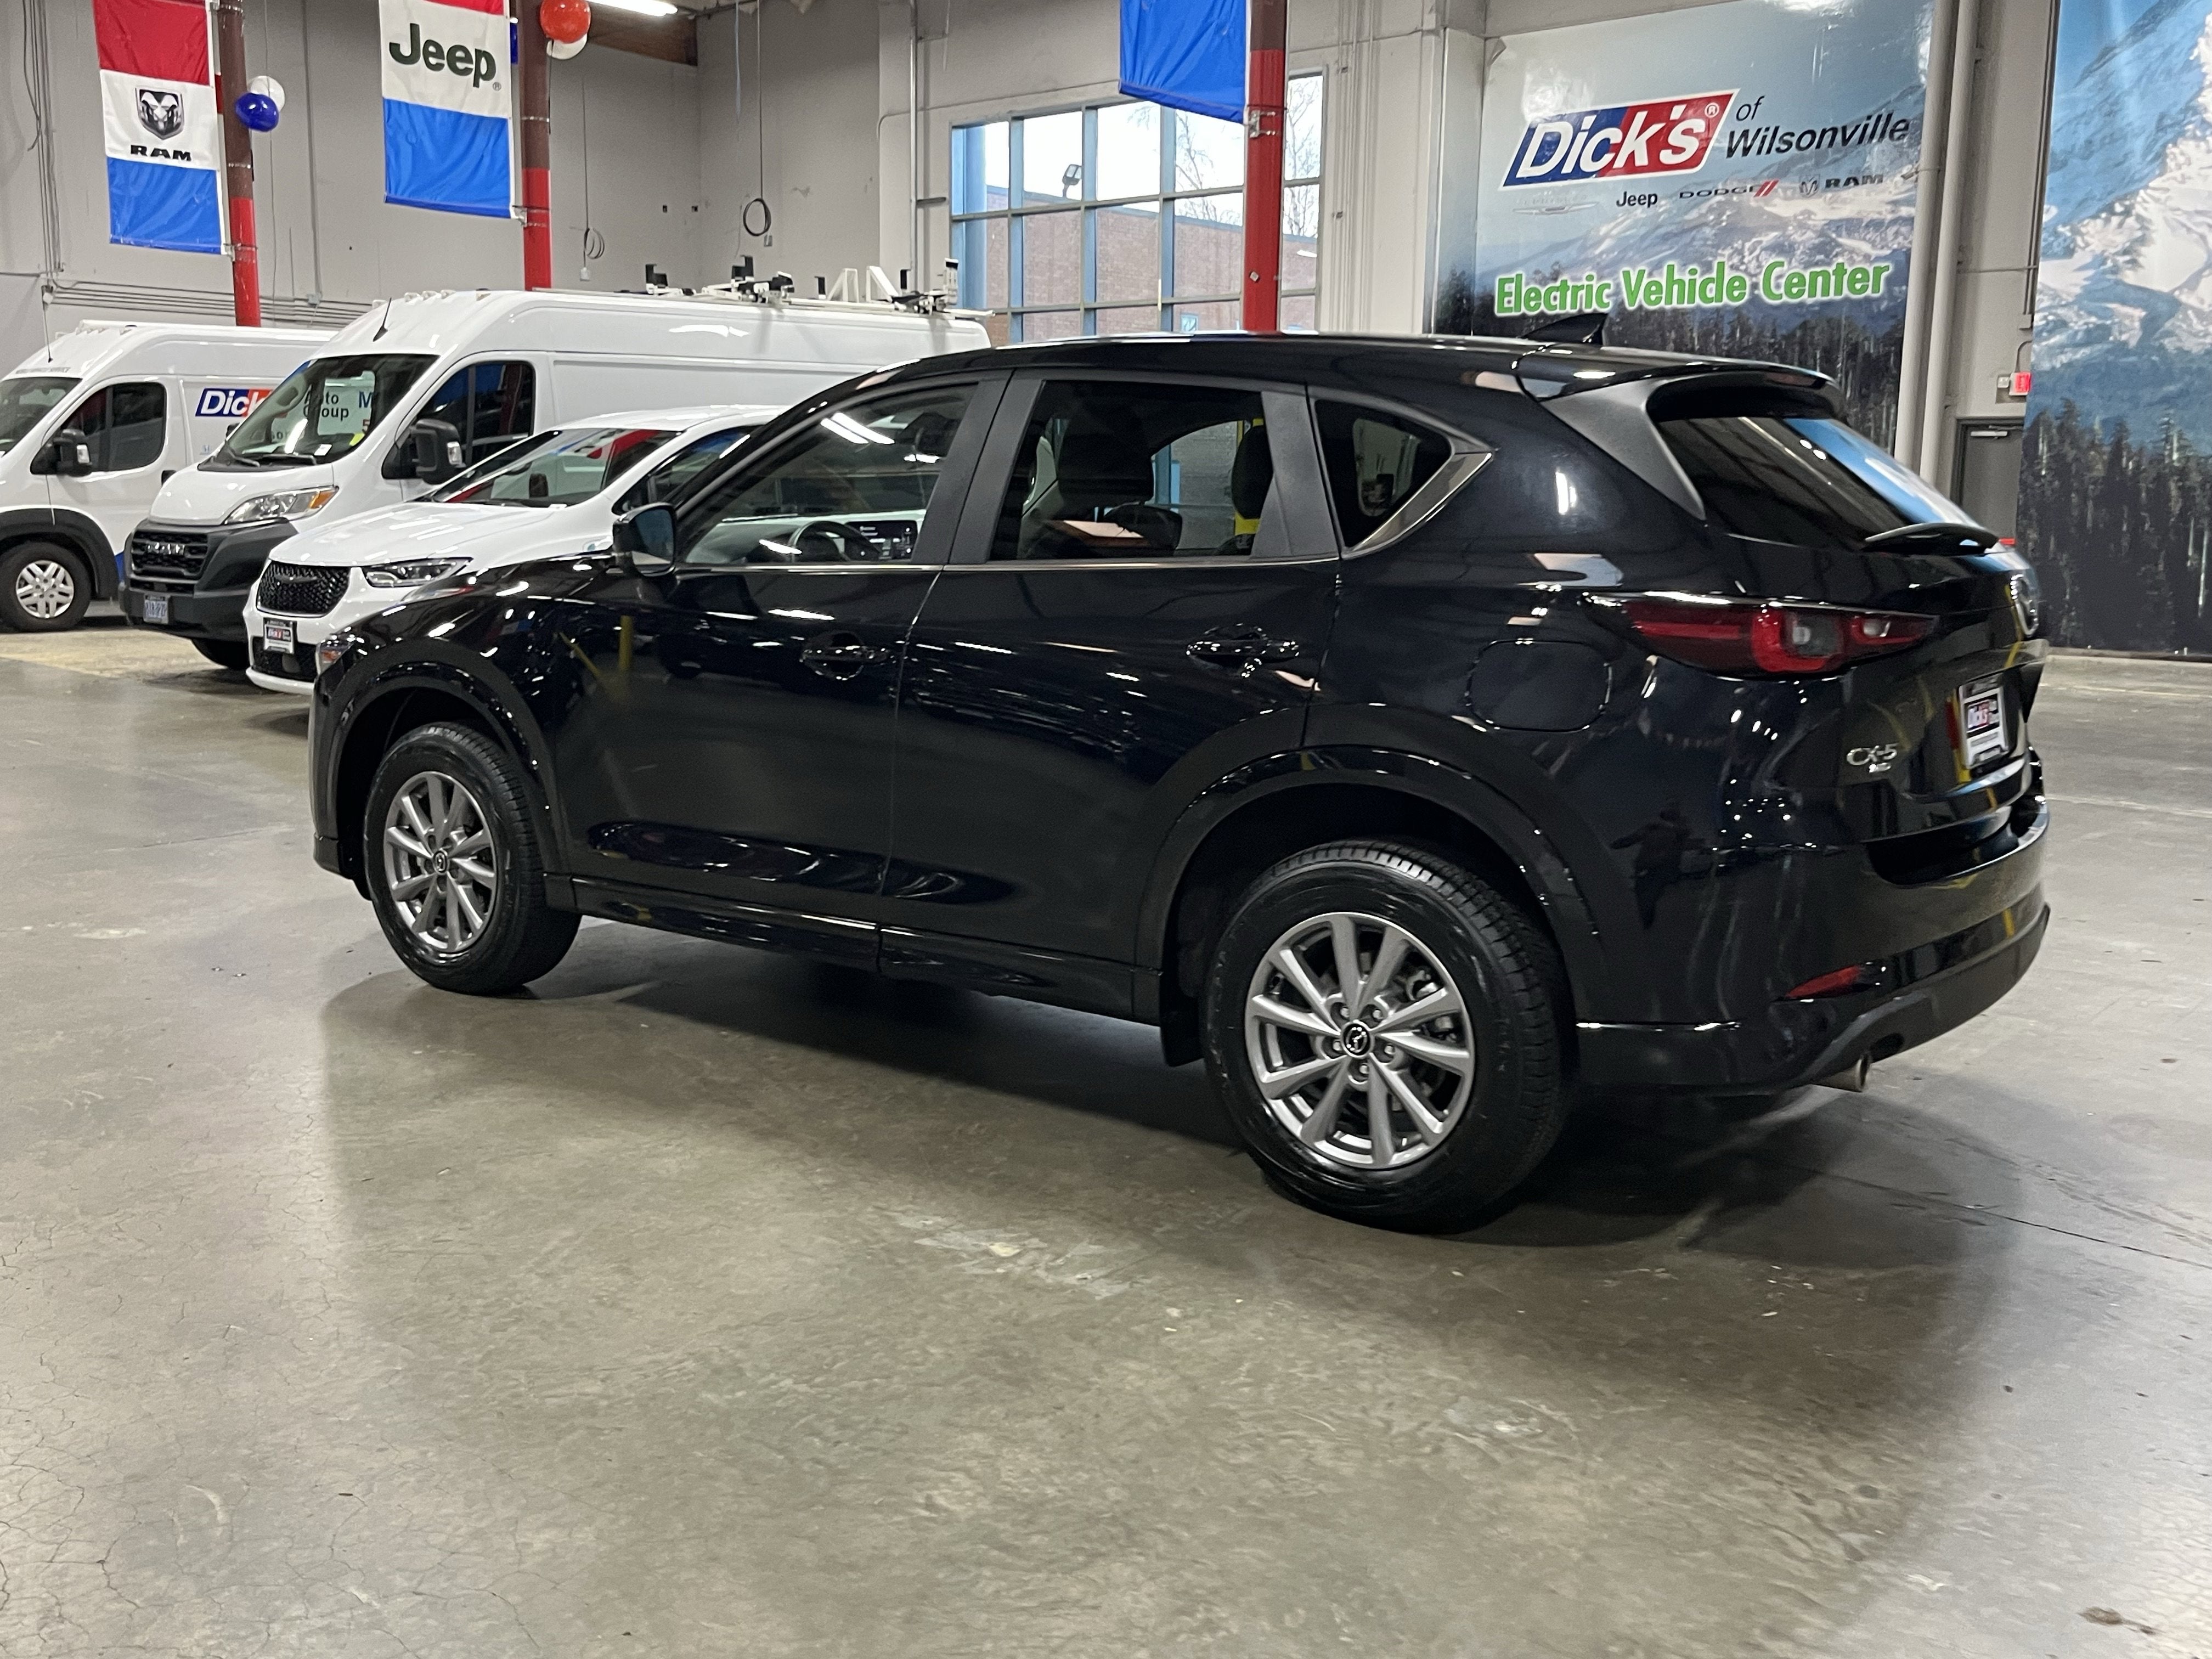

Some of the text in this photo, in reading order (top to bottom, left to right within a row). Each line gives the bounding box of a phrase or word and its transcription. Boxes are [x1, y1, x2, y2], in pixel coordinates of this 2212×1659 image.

[389, 23, 496, 88] Jeep
[1735, 95, 1766, 122] of
[1515, 104, 1705, 179] Dick's
[1725, 111, 1910, 159] Wilsonville
[131, 145, 192, 162] RAM
[1825, 174, 1884, 188] RAM
[1616, 190, 1658, 208] Jeep
[1496, 260, 1891, 313] Electric Vehicle Center
[200, 390, 271, 416] Dick
[1846, 742, 1899, 766] CX-5
